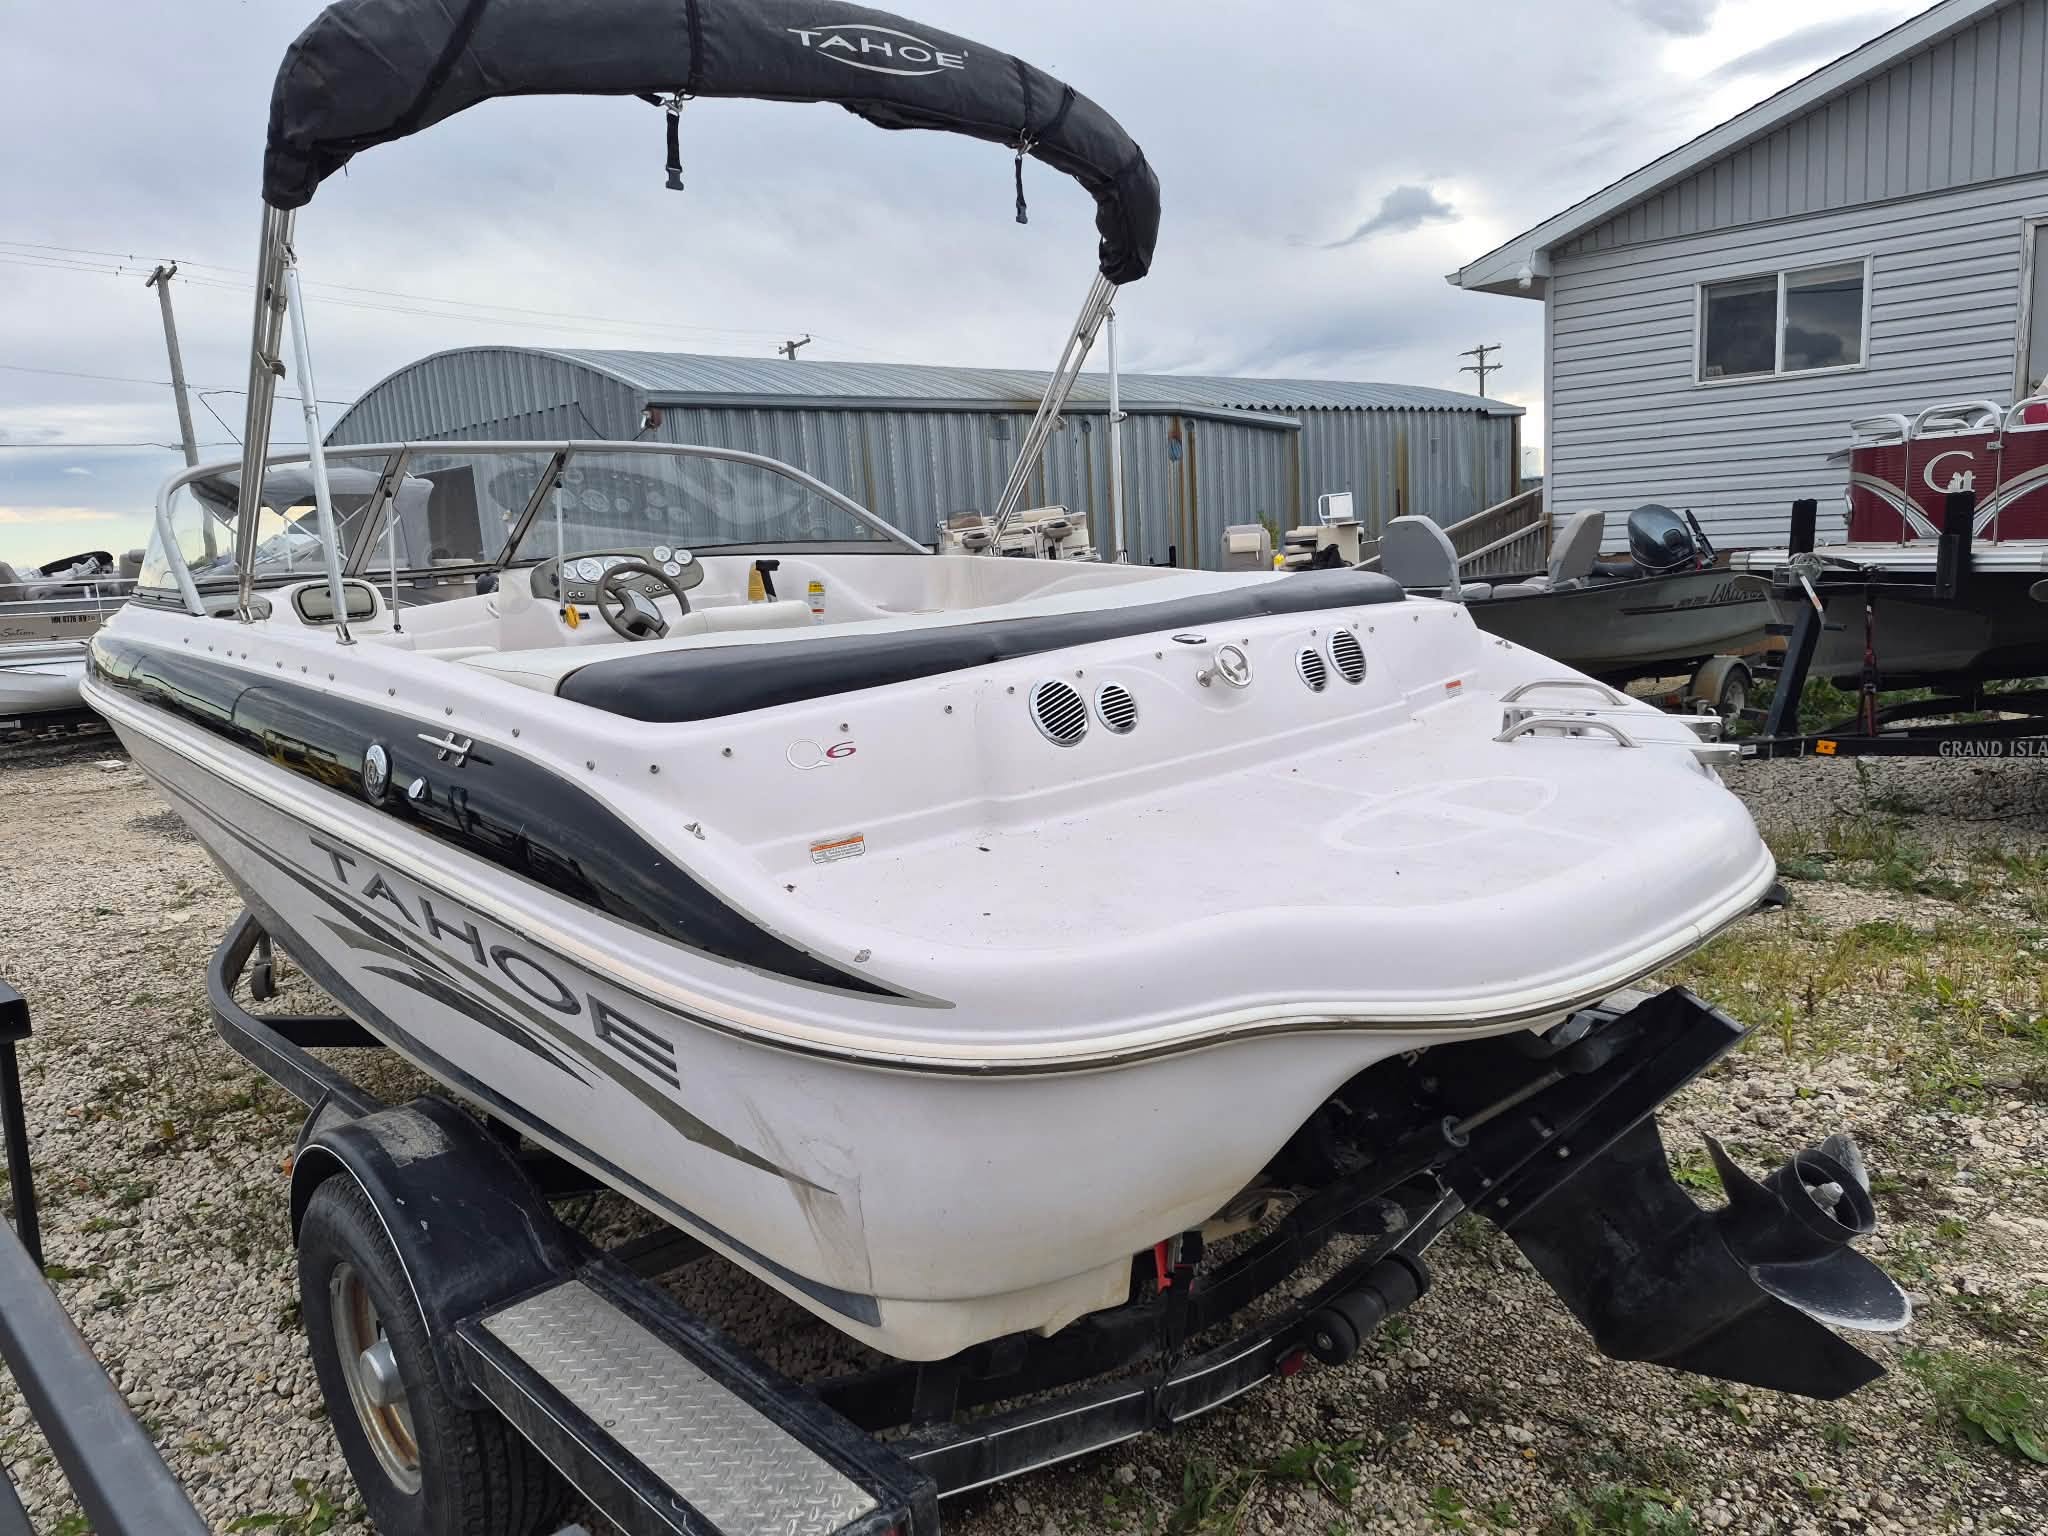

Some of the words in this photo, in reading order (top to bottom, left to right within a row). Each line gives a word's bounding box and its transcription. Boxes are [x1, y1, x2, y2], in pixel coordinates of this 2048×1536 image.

[787, 28, 966, 70] TAHOE
[1938, 740, 2003, 757] GRAND
[309, 834, 681, 1090] TAHOE
